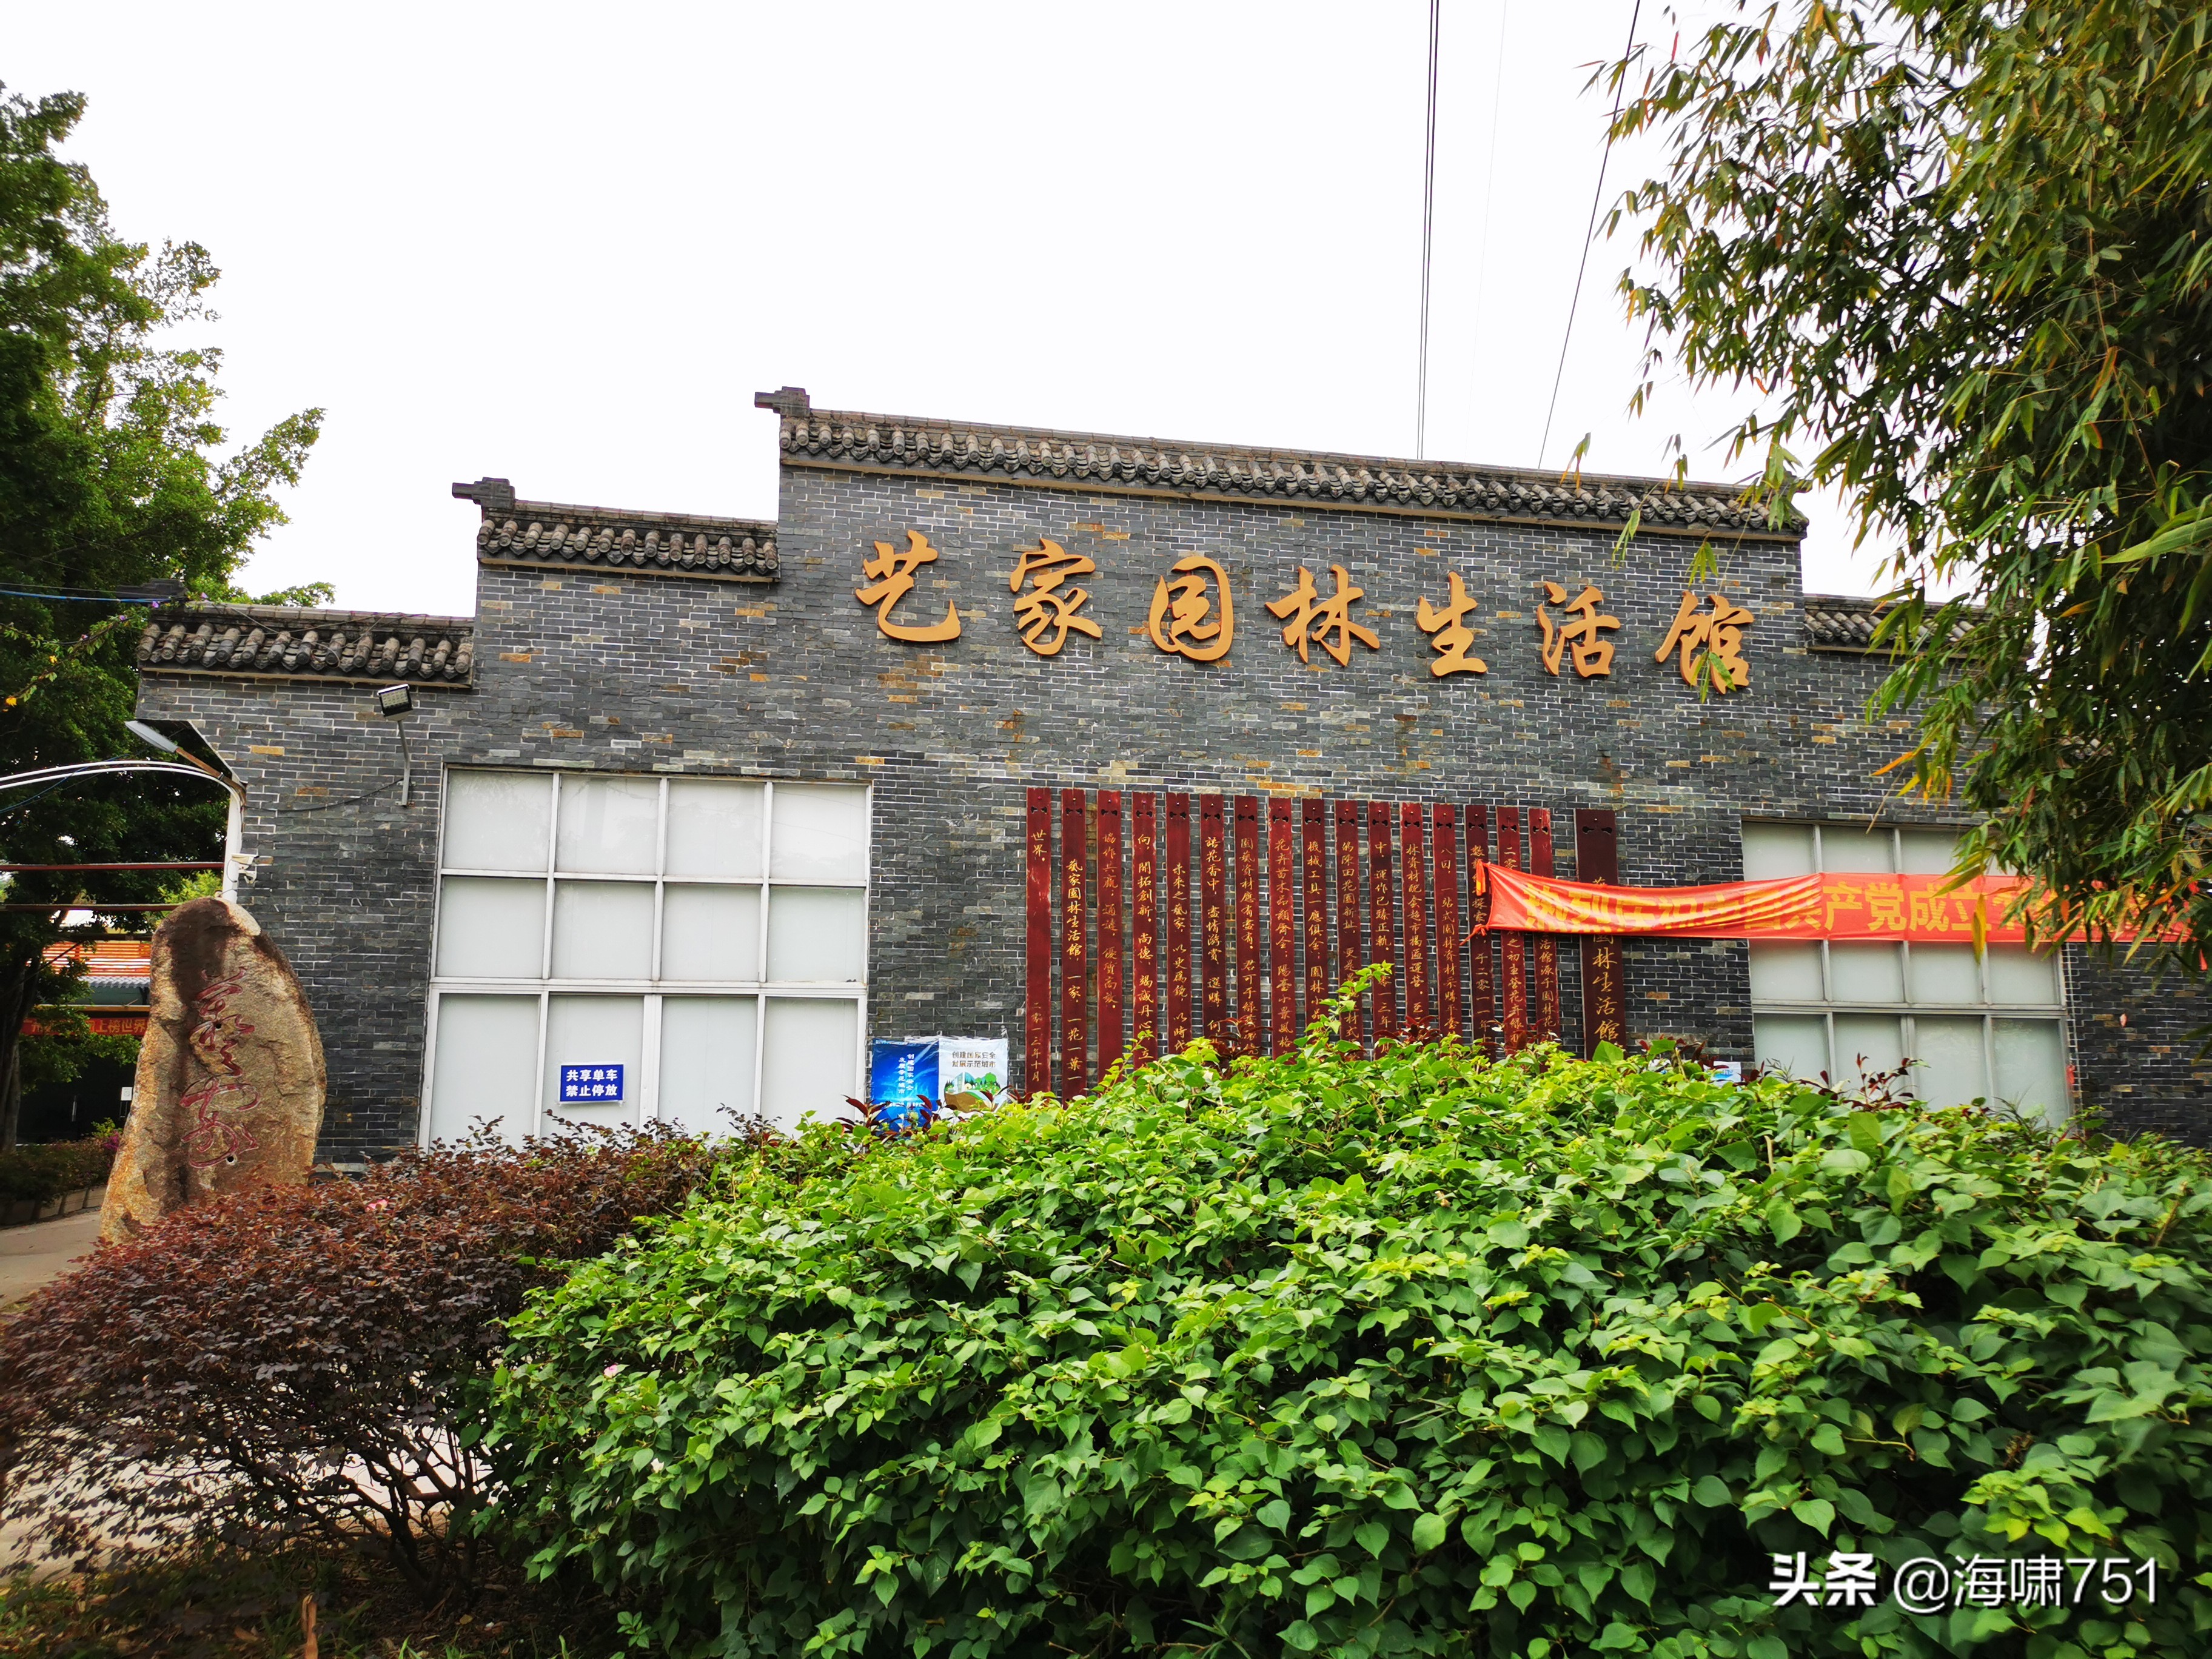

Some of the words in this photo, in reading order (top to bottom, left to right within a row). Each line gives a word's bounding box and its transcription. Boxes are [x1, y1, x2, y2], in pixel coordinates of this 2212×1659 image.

[854, 529, 1756, 695] 艺家园林生活馆
[566, 1069, 618, 1082] 共享单车
[566, 1084, 618, 1097] 禁止停放
